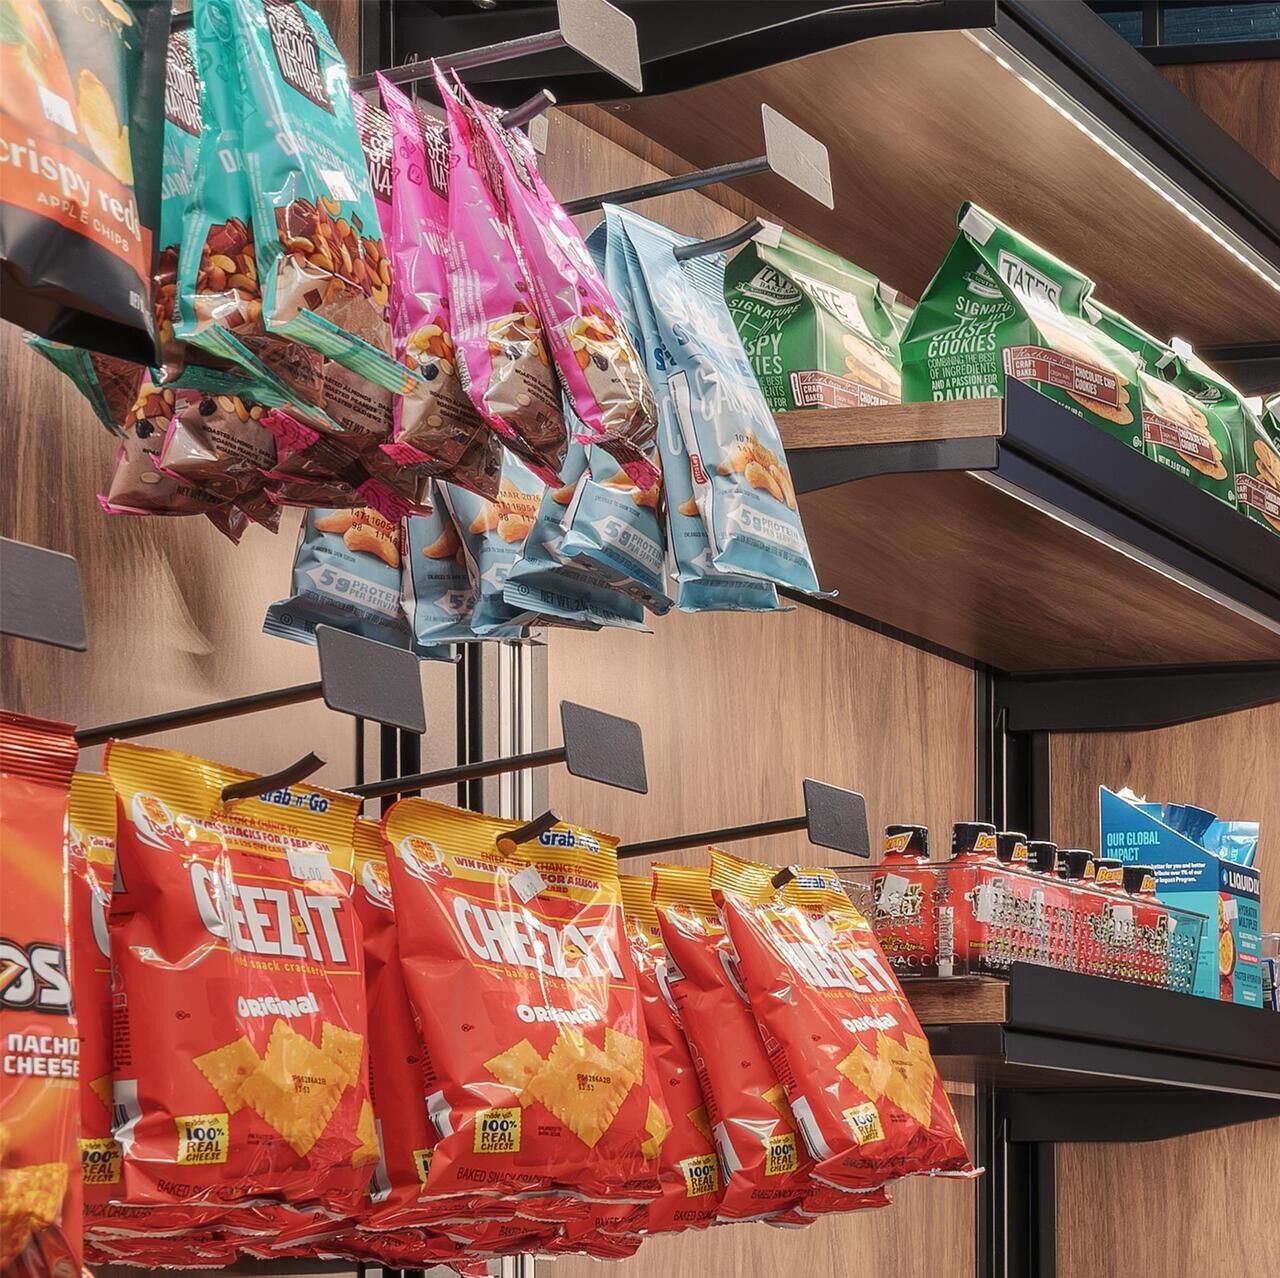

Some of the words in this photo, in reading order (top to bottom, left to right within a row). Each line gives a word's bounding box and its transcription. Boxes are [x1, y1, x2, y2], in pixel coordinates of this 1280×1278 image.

[36, 191, 90, 225] APPLE
[92, 218, 130, 252] CHIPS
[729, 299, 801, 324] SIGNATURE
[928, 334, 997, 357] COOKIES
[965, 354, 976, 363] THE
[977, 352, 995, 362] BEST
[1016, 359, 1036, 369] CRAFT
[930, 370, 940, 379] OF
[942, 362, 996, 376] INGREDIENTS
[1016, 368, 1036, 378] BAKED
[1075, 365, 1104, 385] CHOCOLATE
[1103, 375, 1116, 389] CHIP
[932, 380, 945, 390] AND
[951, 377, 983, 387] PASSION
[983, 374, 998, 384] FOR
[1075, 379, 1098, 396] COOKIES
[539, 831, 575, 847] Grab
[1107, 832, 1124, 846] OUR
[1126, 831, 1160, 845] GLOBAL
[184, 1126, 224, 1143] 100%
[480, 1118, 518, 1135] 100%
[481, 1131, 516, 1145] REAL
[186, 1141, 221, 1155] REAL
[184, 1152, 222, 1164] CHEESE
